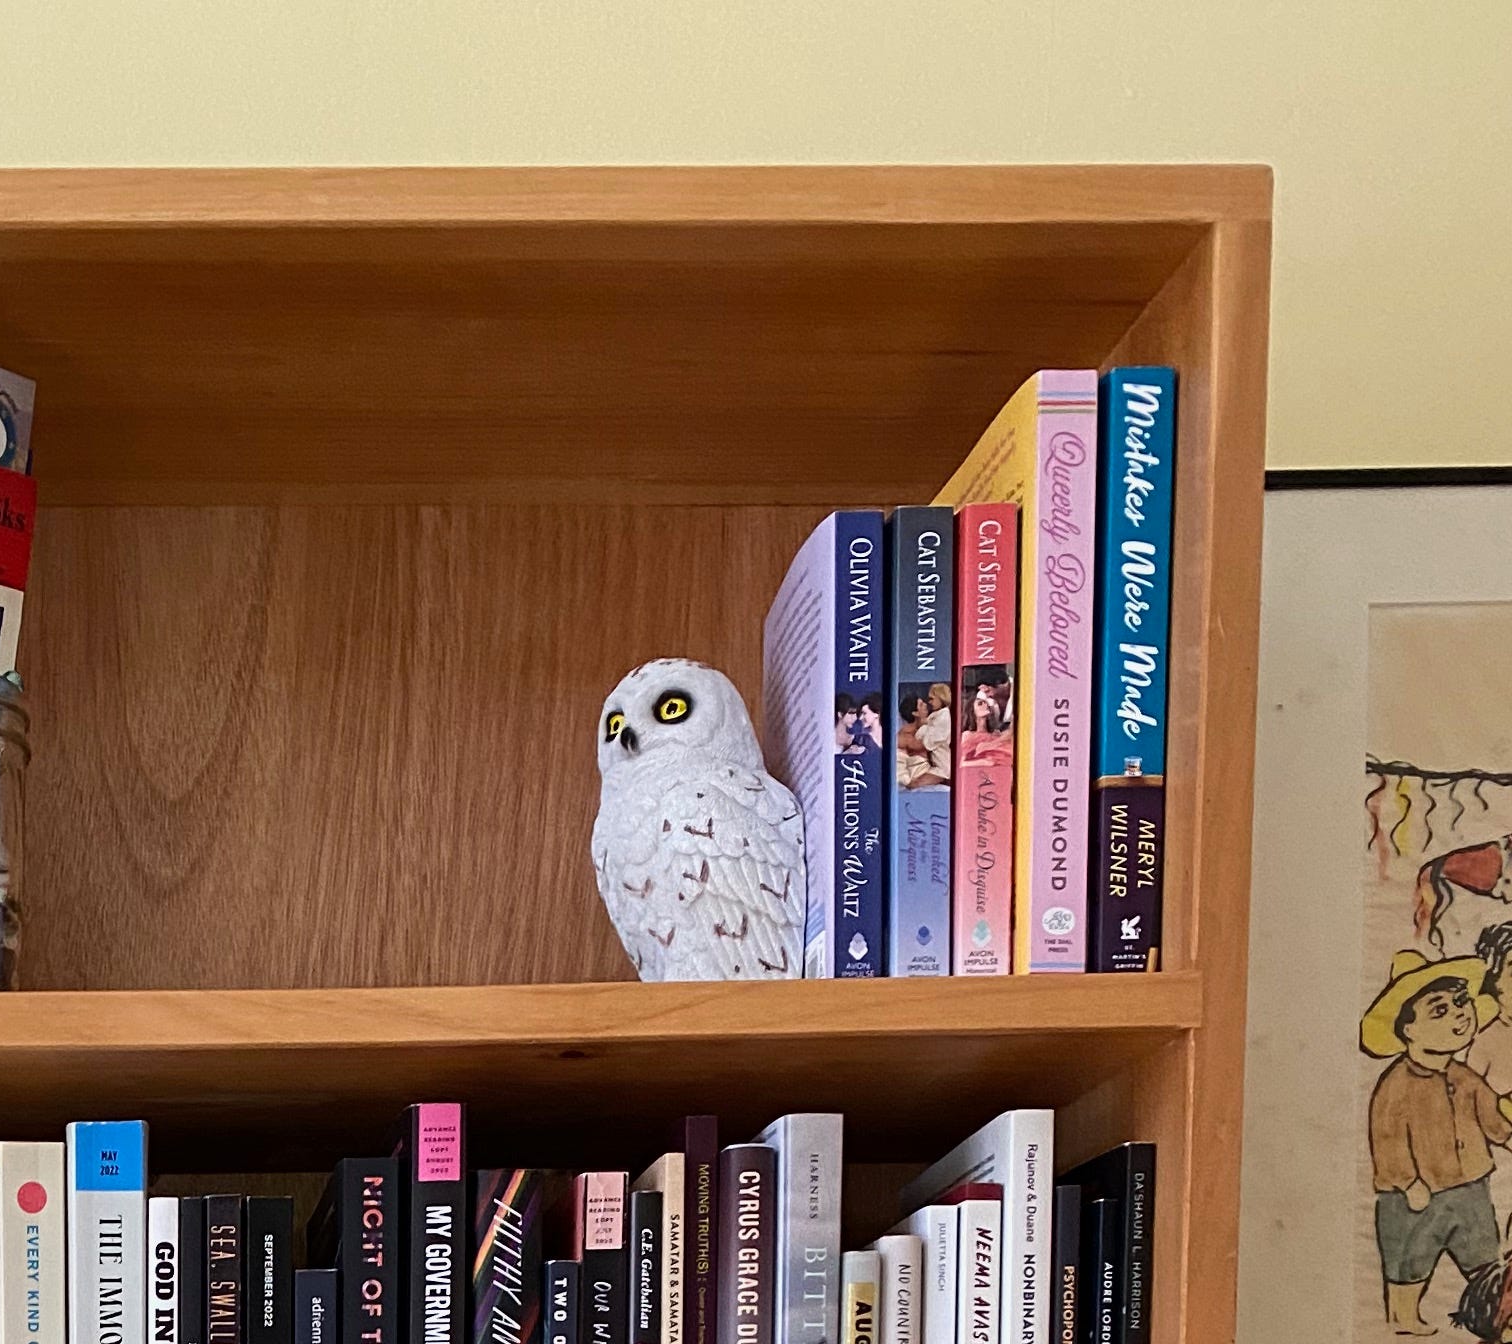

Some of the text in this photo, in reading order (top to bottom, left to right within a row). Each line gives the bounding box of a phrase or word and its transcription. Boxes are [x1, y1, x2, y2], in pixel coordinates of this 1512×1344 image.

[1120, 383, 1163, 740] Mistakes Were Made
[1053, 698, 1069, 891] SUSIE DUMOND
[425, 1205, 451, 1238] MY
[155, 1241, 177, 1301] GOD
[156, 1308, 174, 1334] IN
